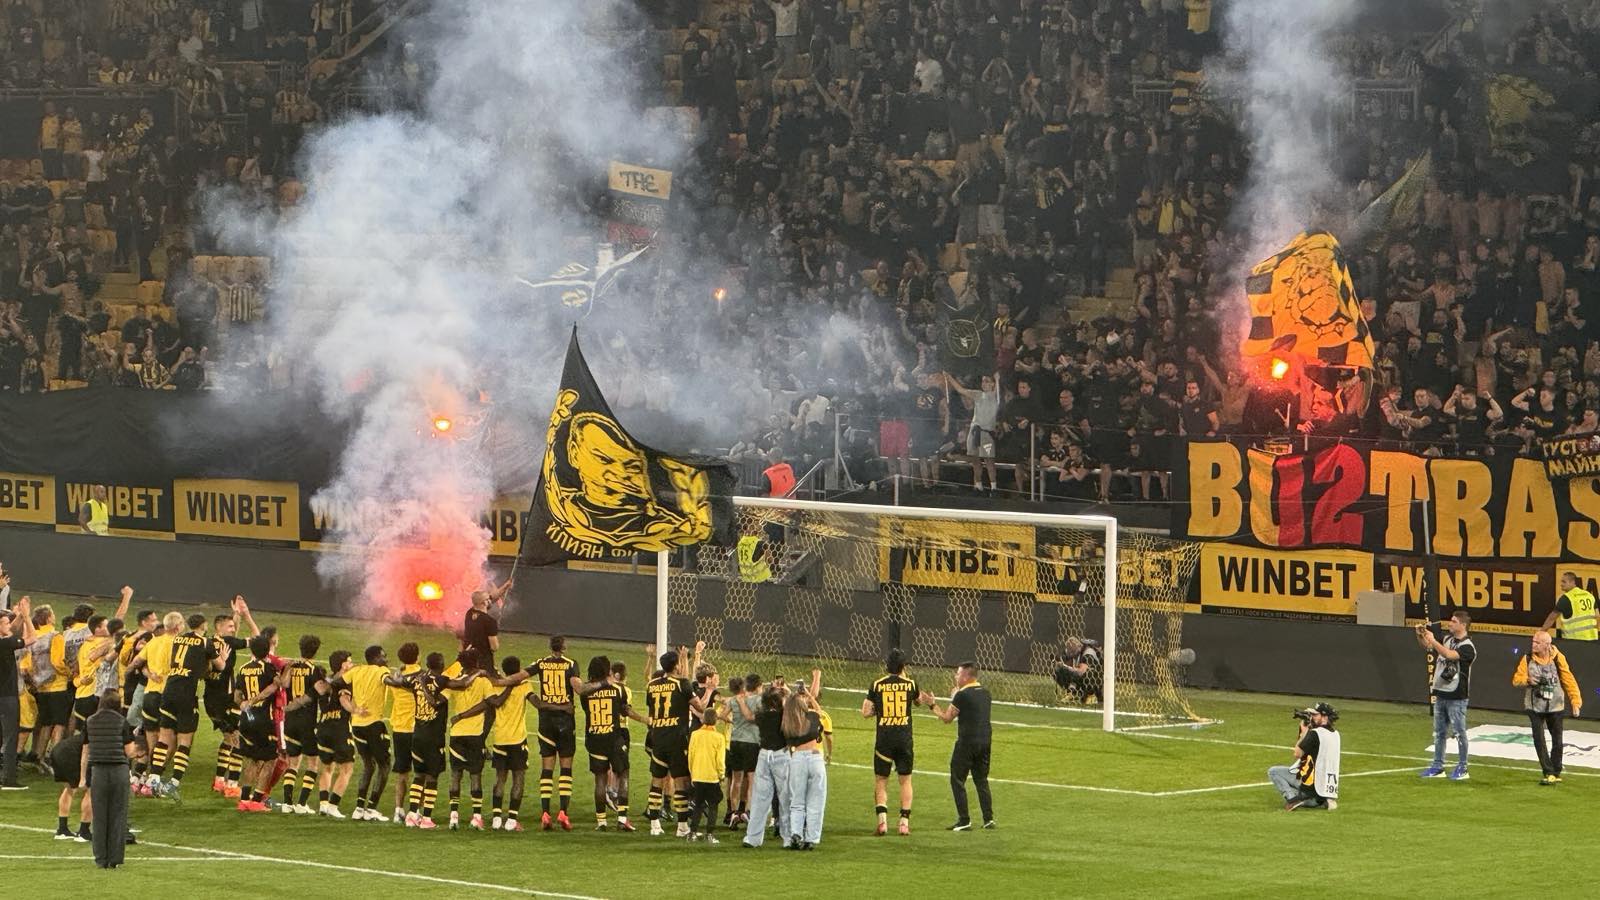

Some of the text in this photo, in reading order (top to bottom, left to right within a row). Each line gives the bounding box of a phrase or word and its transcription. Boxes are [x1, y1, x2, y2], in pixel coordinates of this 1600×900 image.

[0, 478, 43, 510] BET
[186, 491, 287, 527] WINBET
[1217, 555, 1357, 599] WINBET
[1390, 565, 1539, 612] WNBET
[1580, 598, 1592, 611] 30
[174, 644, 189, 669] 4
[543, 669, 567, 695] 30
[877, 682, 912, 692] МЕОТИ
[588, 698, 613, 726] 82
[882, 691, 908, 717] 66
[879, 716, 909, 726] PIMK
